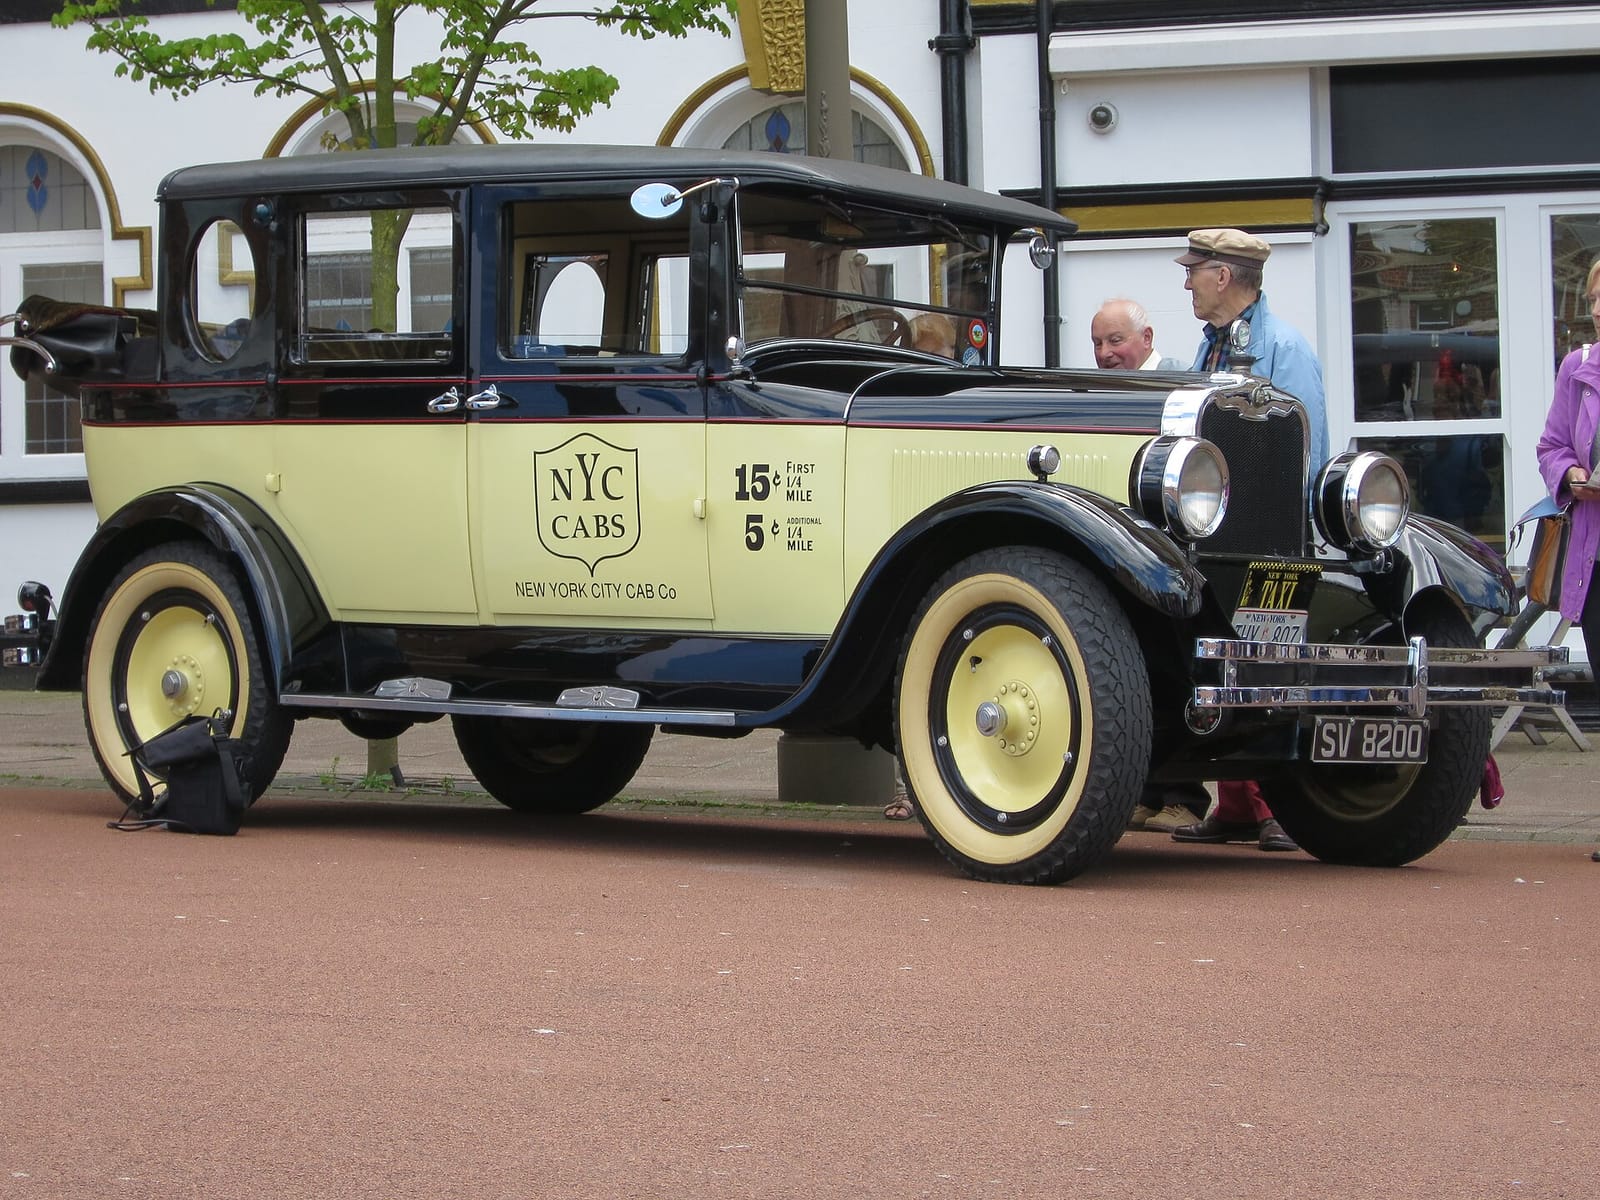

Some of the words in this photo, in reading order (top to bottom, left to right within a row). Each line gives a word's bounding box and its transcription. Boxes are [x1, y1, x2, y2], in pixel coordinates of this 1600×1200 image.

[786, 461, 816, 474] FIRST
[551, 453, 624, 501] NYC
[786, 475, 802, 488] 1/4
[786, 489, 813, 502] MILE
[551, 513, 626, 539] CABS
[786, 517, 822, 525] ADDITIONAL
[787, 526, 802, 539] 1/4
[787, 540, 813, 552] MILE
[1267, 571, 1281, 580] NEW
[515, 581, 546, 598] NEW
[549, 582, 588, 599] YORK
[590, 582, 622, 599] CITY
[625, 583, 655, 600] CAB
[658, 583, 677, 600] Co
[1260, 580, 1298, 609] TAXI
[1251, 613, 1266, 623] NEW
[1268, 614, 1287, 624] YORK
[1321, 722, 1352, 758] SV
[1362, 723, 1422, 758] 8200
